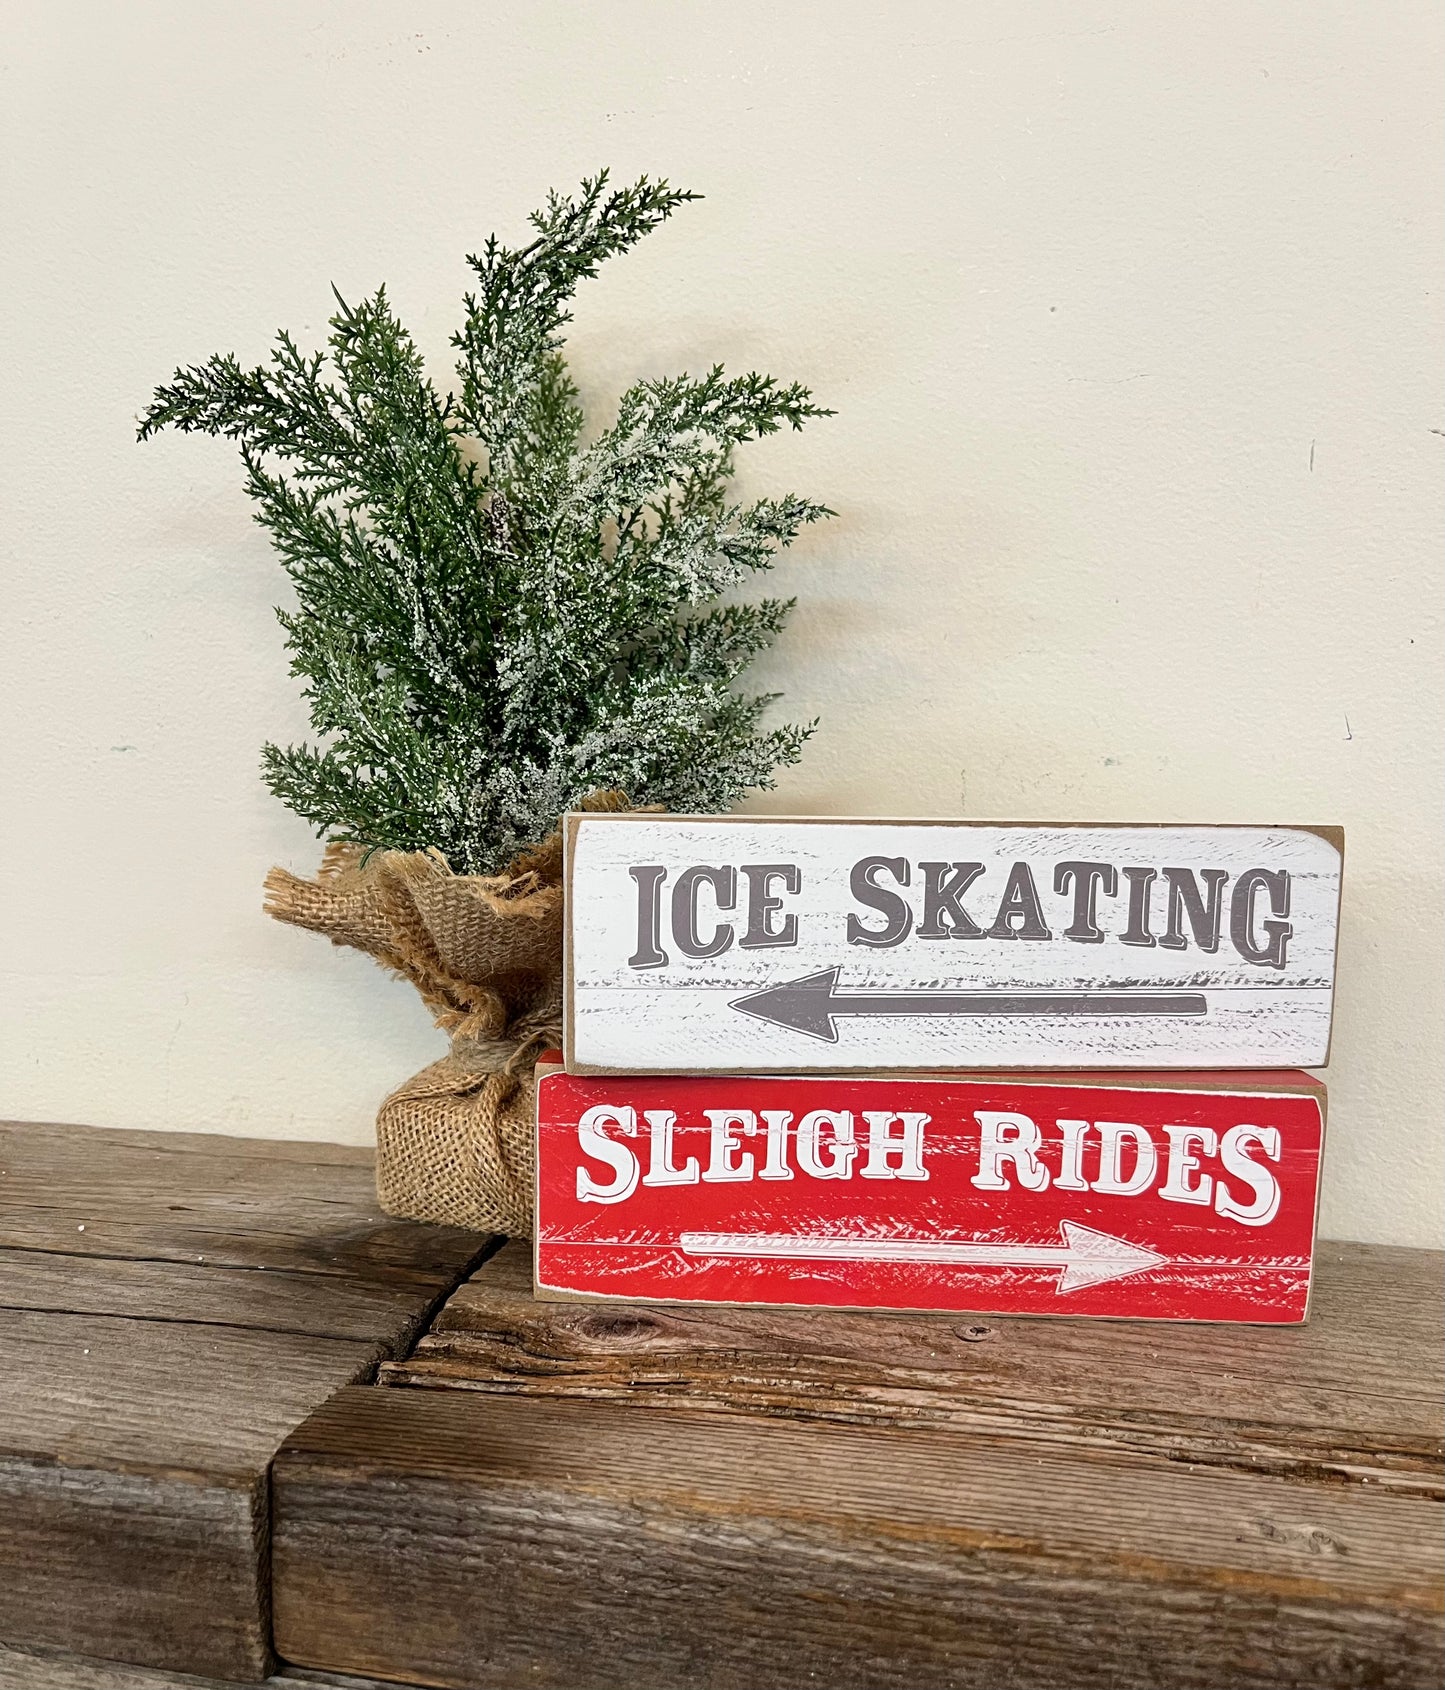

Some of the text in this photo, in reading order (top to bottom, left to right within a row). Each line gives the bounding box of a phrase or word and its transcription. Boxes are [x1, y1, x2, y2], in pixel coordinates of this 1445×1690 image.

[628, 855, 1293, 970] ICE SKATING
[576, 1104, 1282, 1227] SLEIGH RIDES
